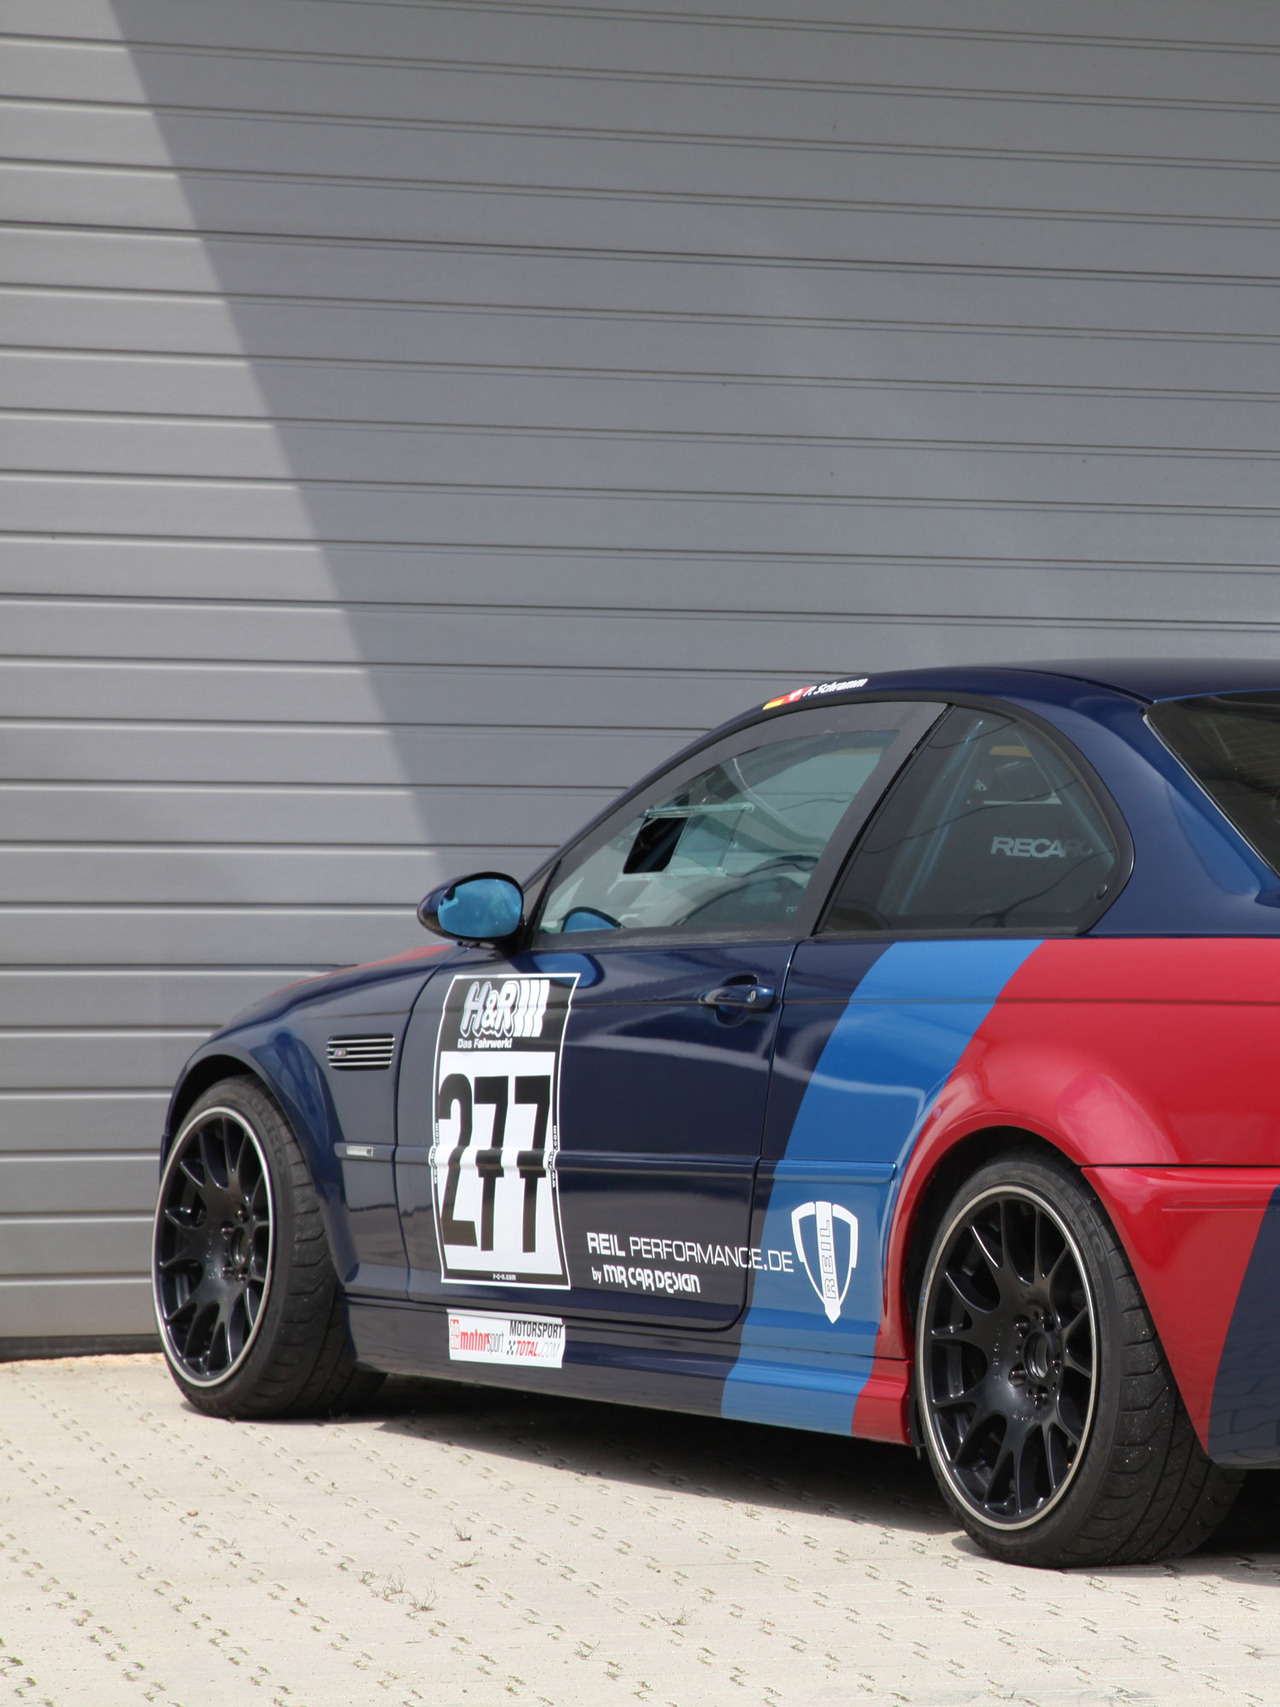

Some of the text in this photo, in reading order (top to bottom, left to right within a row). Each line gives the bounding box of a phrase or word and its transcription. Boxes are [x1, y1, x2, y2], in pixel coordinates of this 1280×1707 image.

[813, 678, 868, 695] Schramm
[457, 1038, 513, 1048] Das Fahrwerk!
[437, 1073, 551, 1252] 277
[586, 1232, 795, 1273] REIL PERFORMANCE.DE
[820, 1218, 837, 1300] REIL
[591, 1266, 602, 1285] by
[509, 1320, 563, 1339] MOTORSPORT
[460, 1328, 505, 1356] motorsport
[515, 1340, 561, 1358] TOTAL.COM
